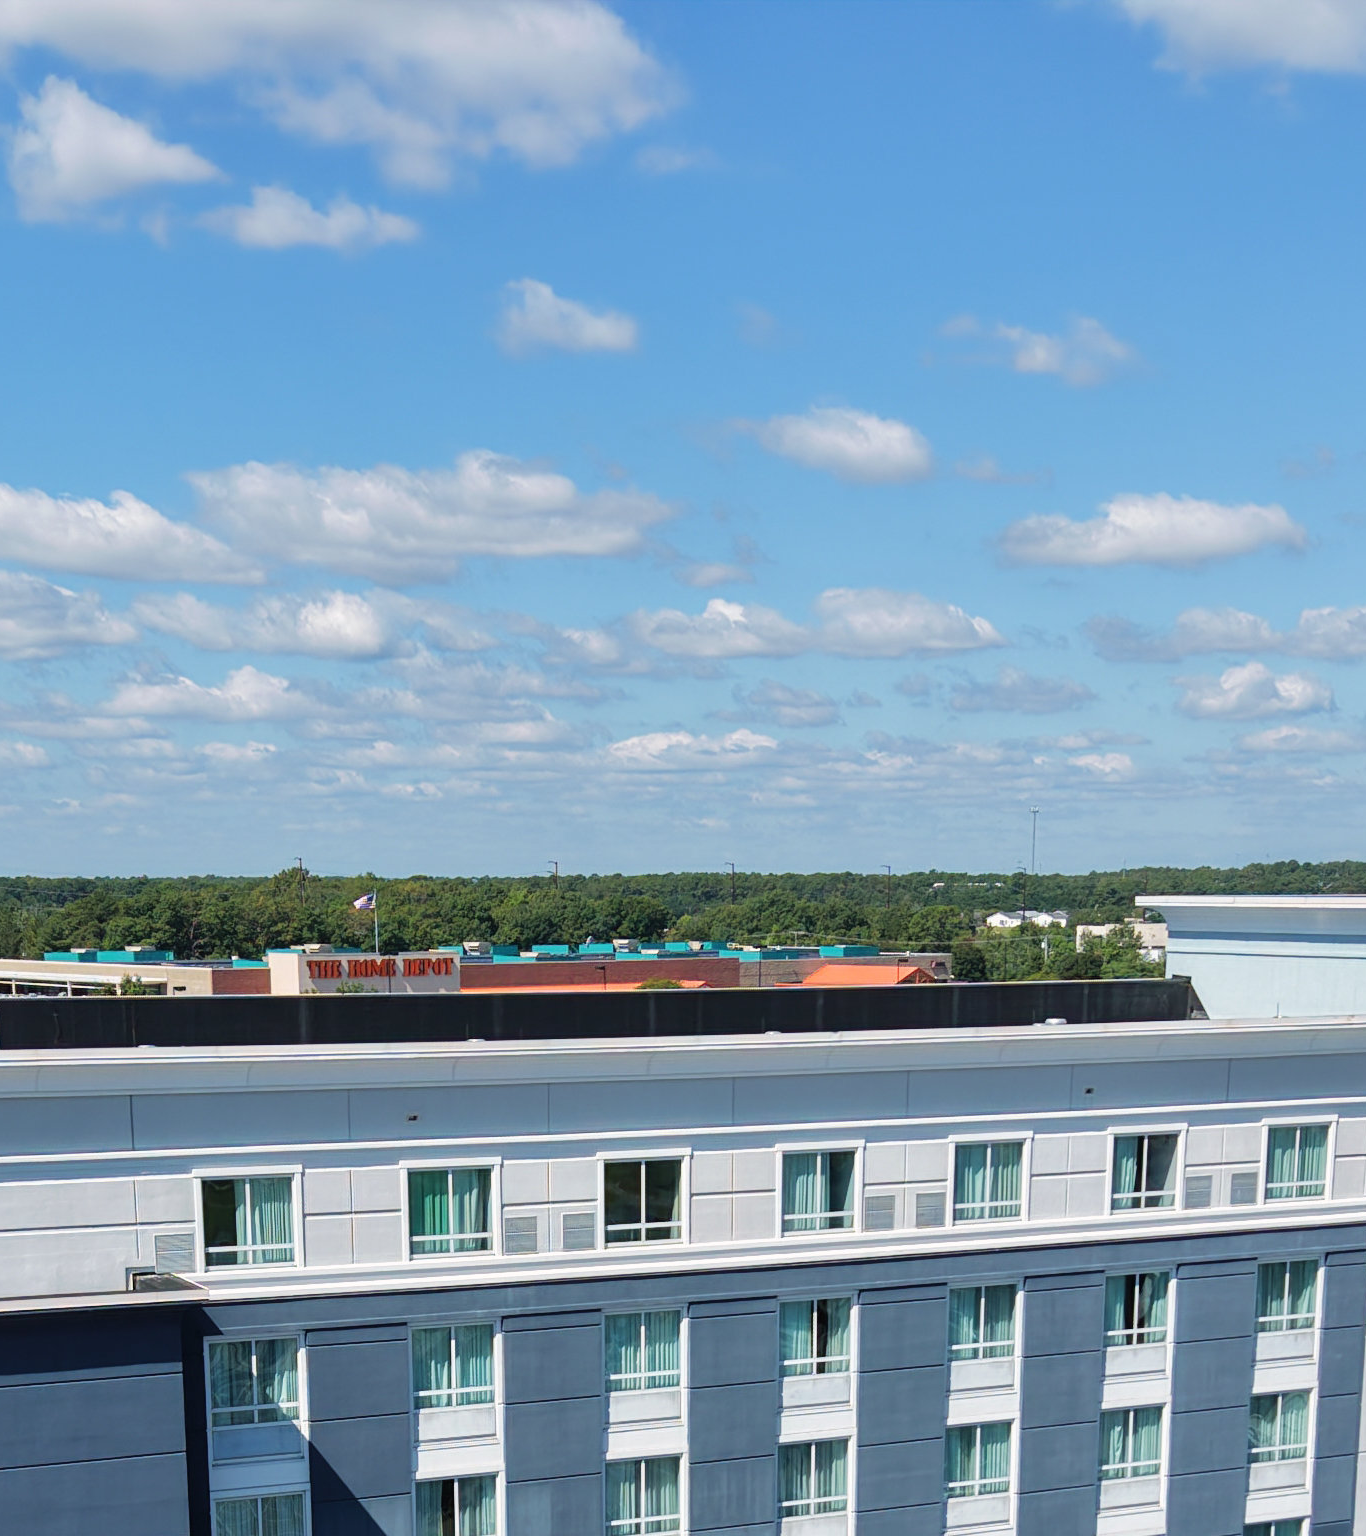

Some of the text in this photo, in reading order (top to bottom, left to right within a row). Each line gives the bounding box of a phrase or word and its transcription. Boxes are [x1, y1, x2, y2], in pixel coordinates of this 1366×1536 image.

[306, 957, 454, 979] THE HOME DEPOT
